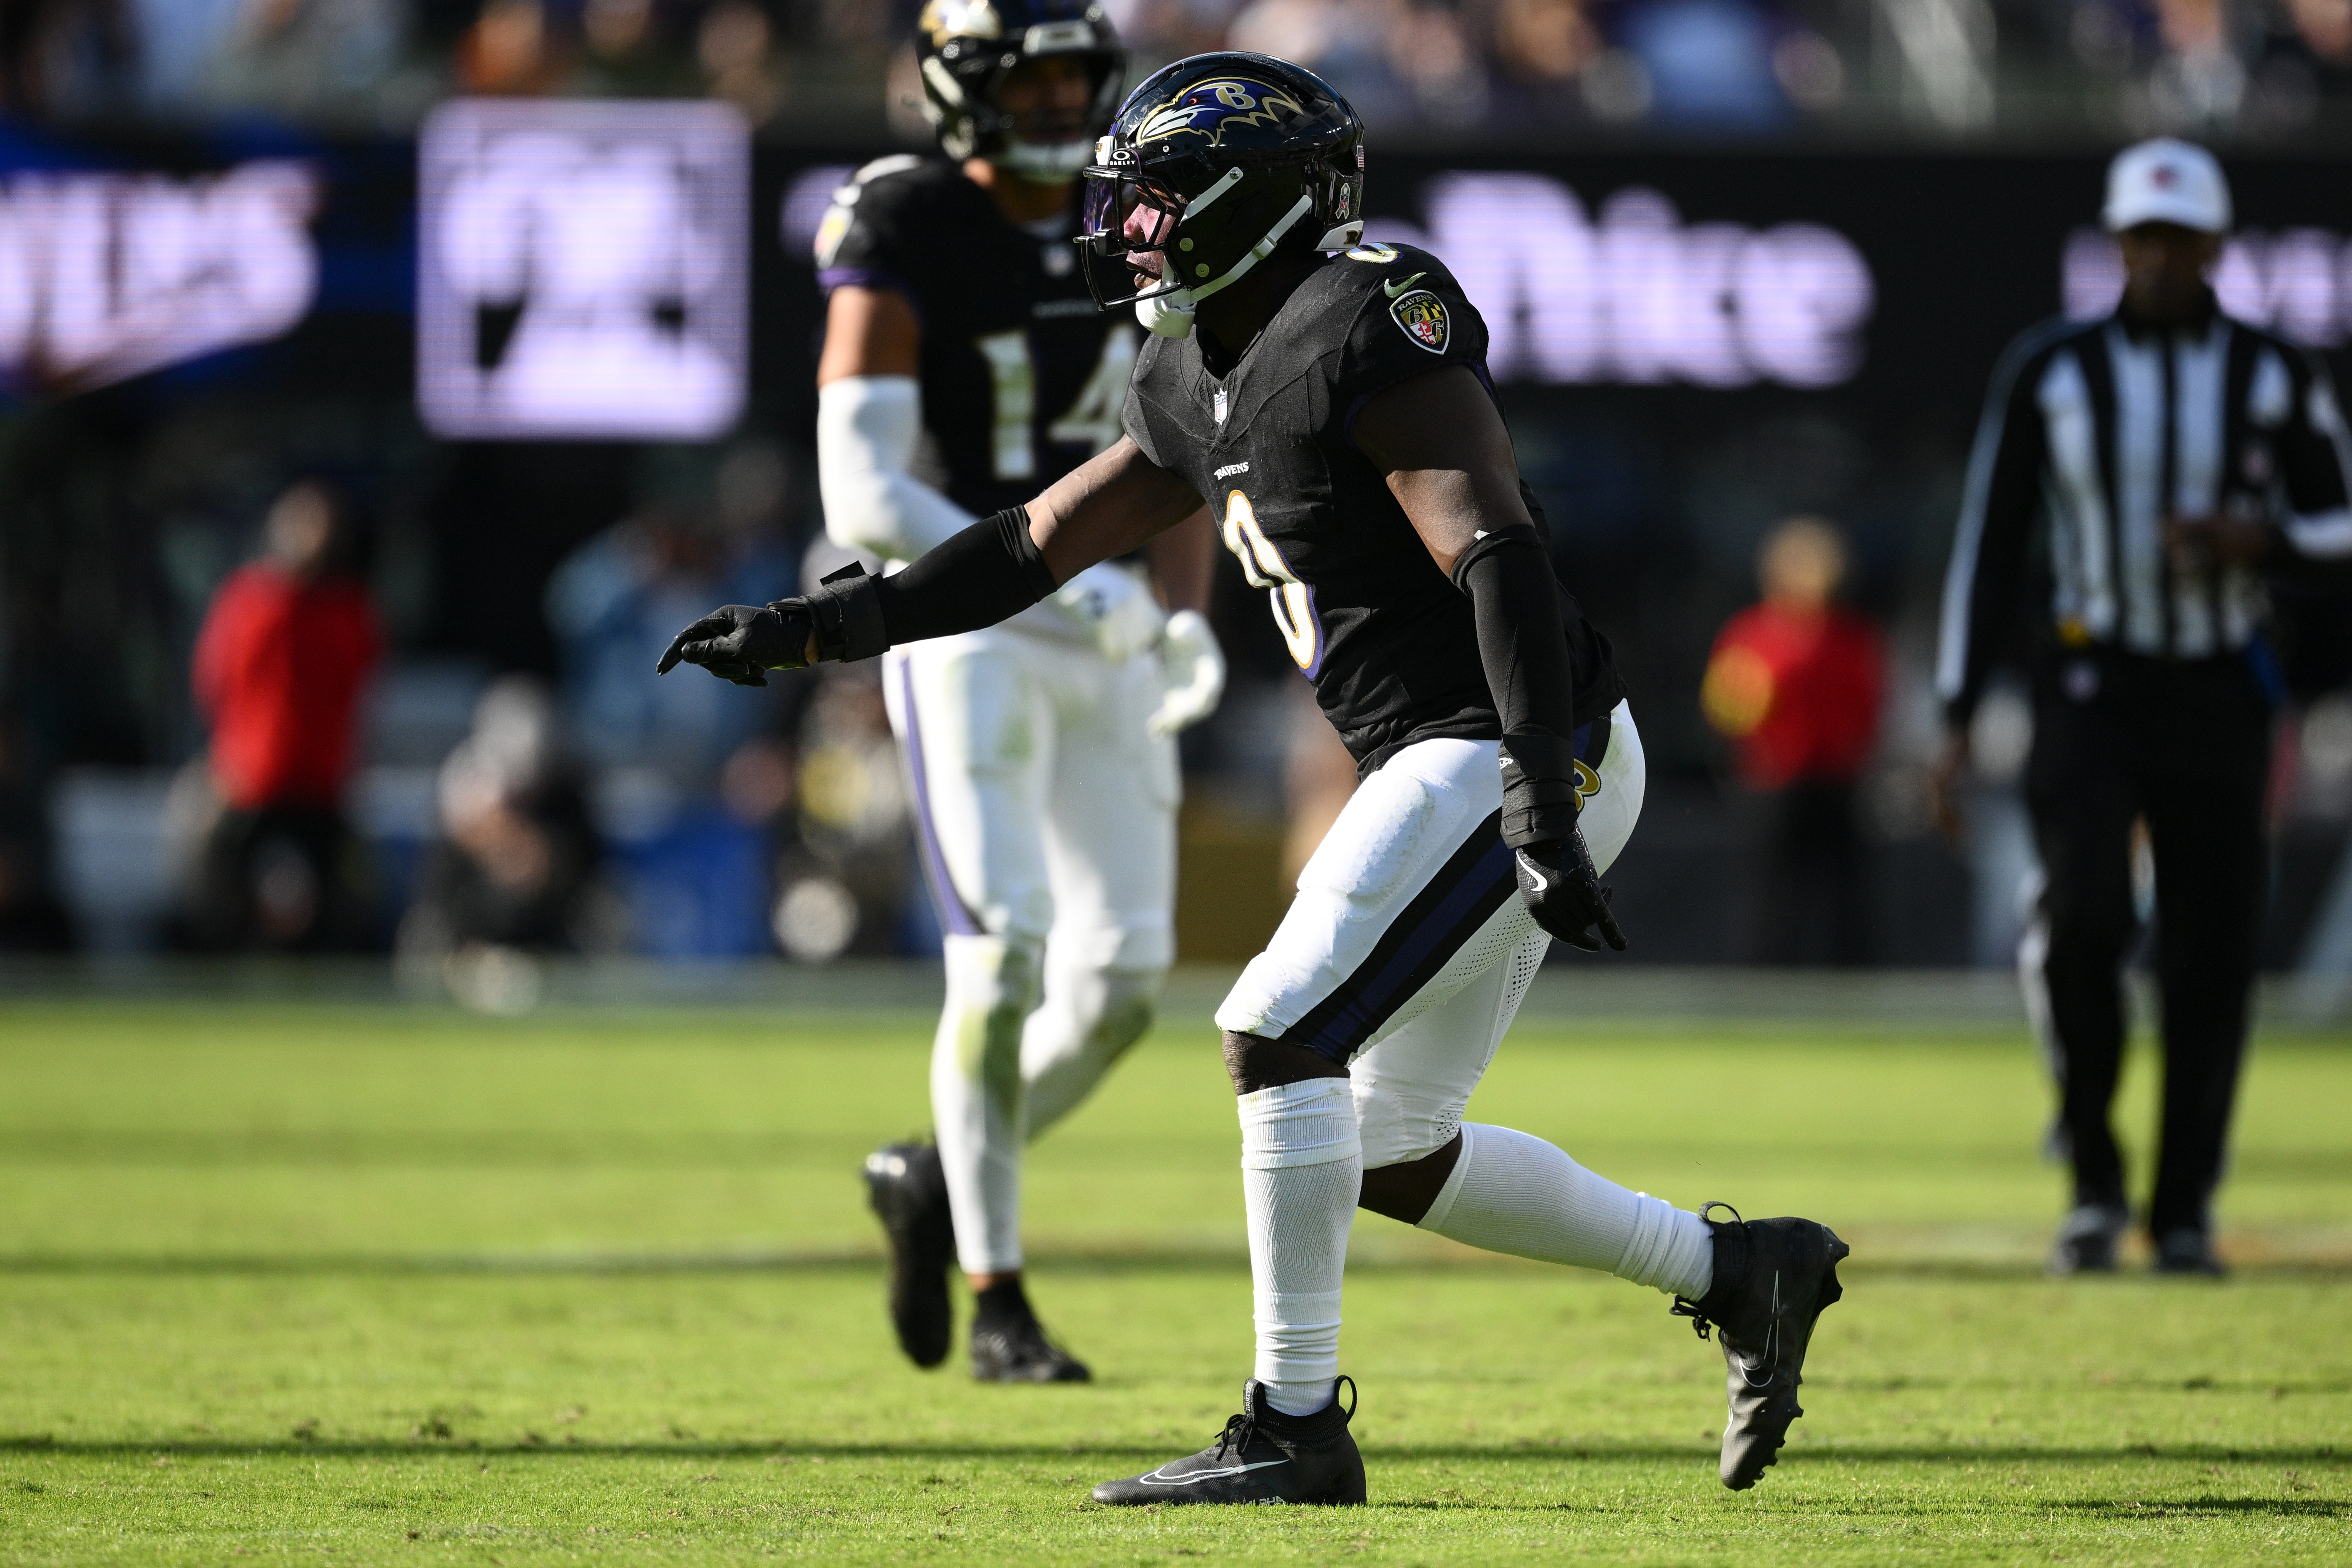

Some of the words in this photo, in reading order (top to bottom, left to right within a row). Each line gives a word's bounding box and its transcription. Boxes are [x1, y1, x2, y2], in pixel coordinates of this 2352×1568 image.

[1207, 82, 1256, 109] B
[1397, 295, 1433, 311] RAVENS
[976, 325, 1137, 481] 14
[1214, 462, 1249, 480] RAVENS
[1223, 489, 1324, 680] 0
[1249, 1496, 1284, 1505] PHA
